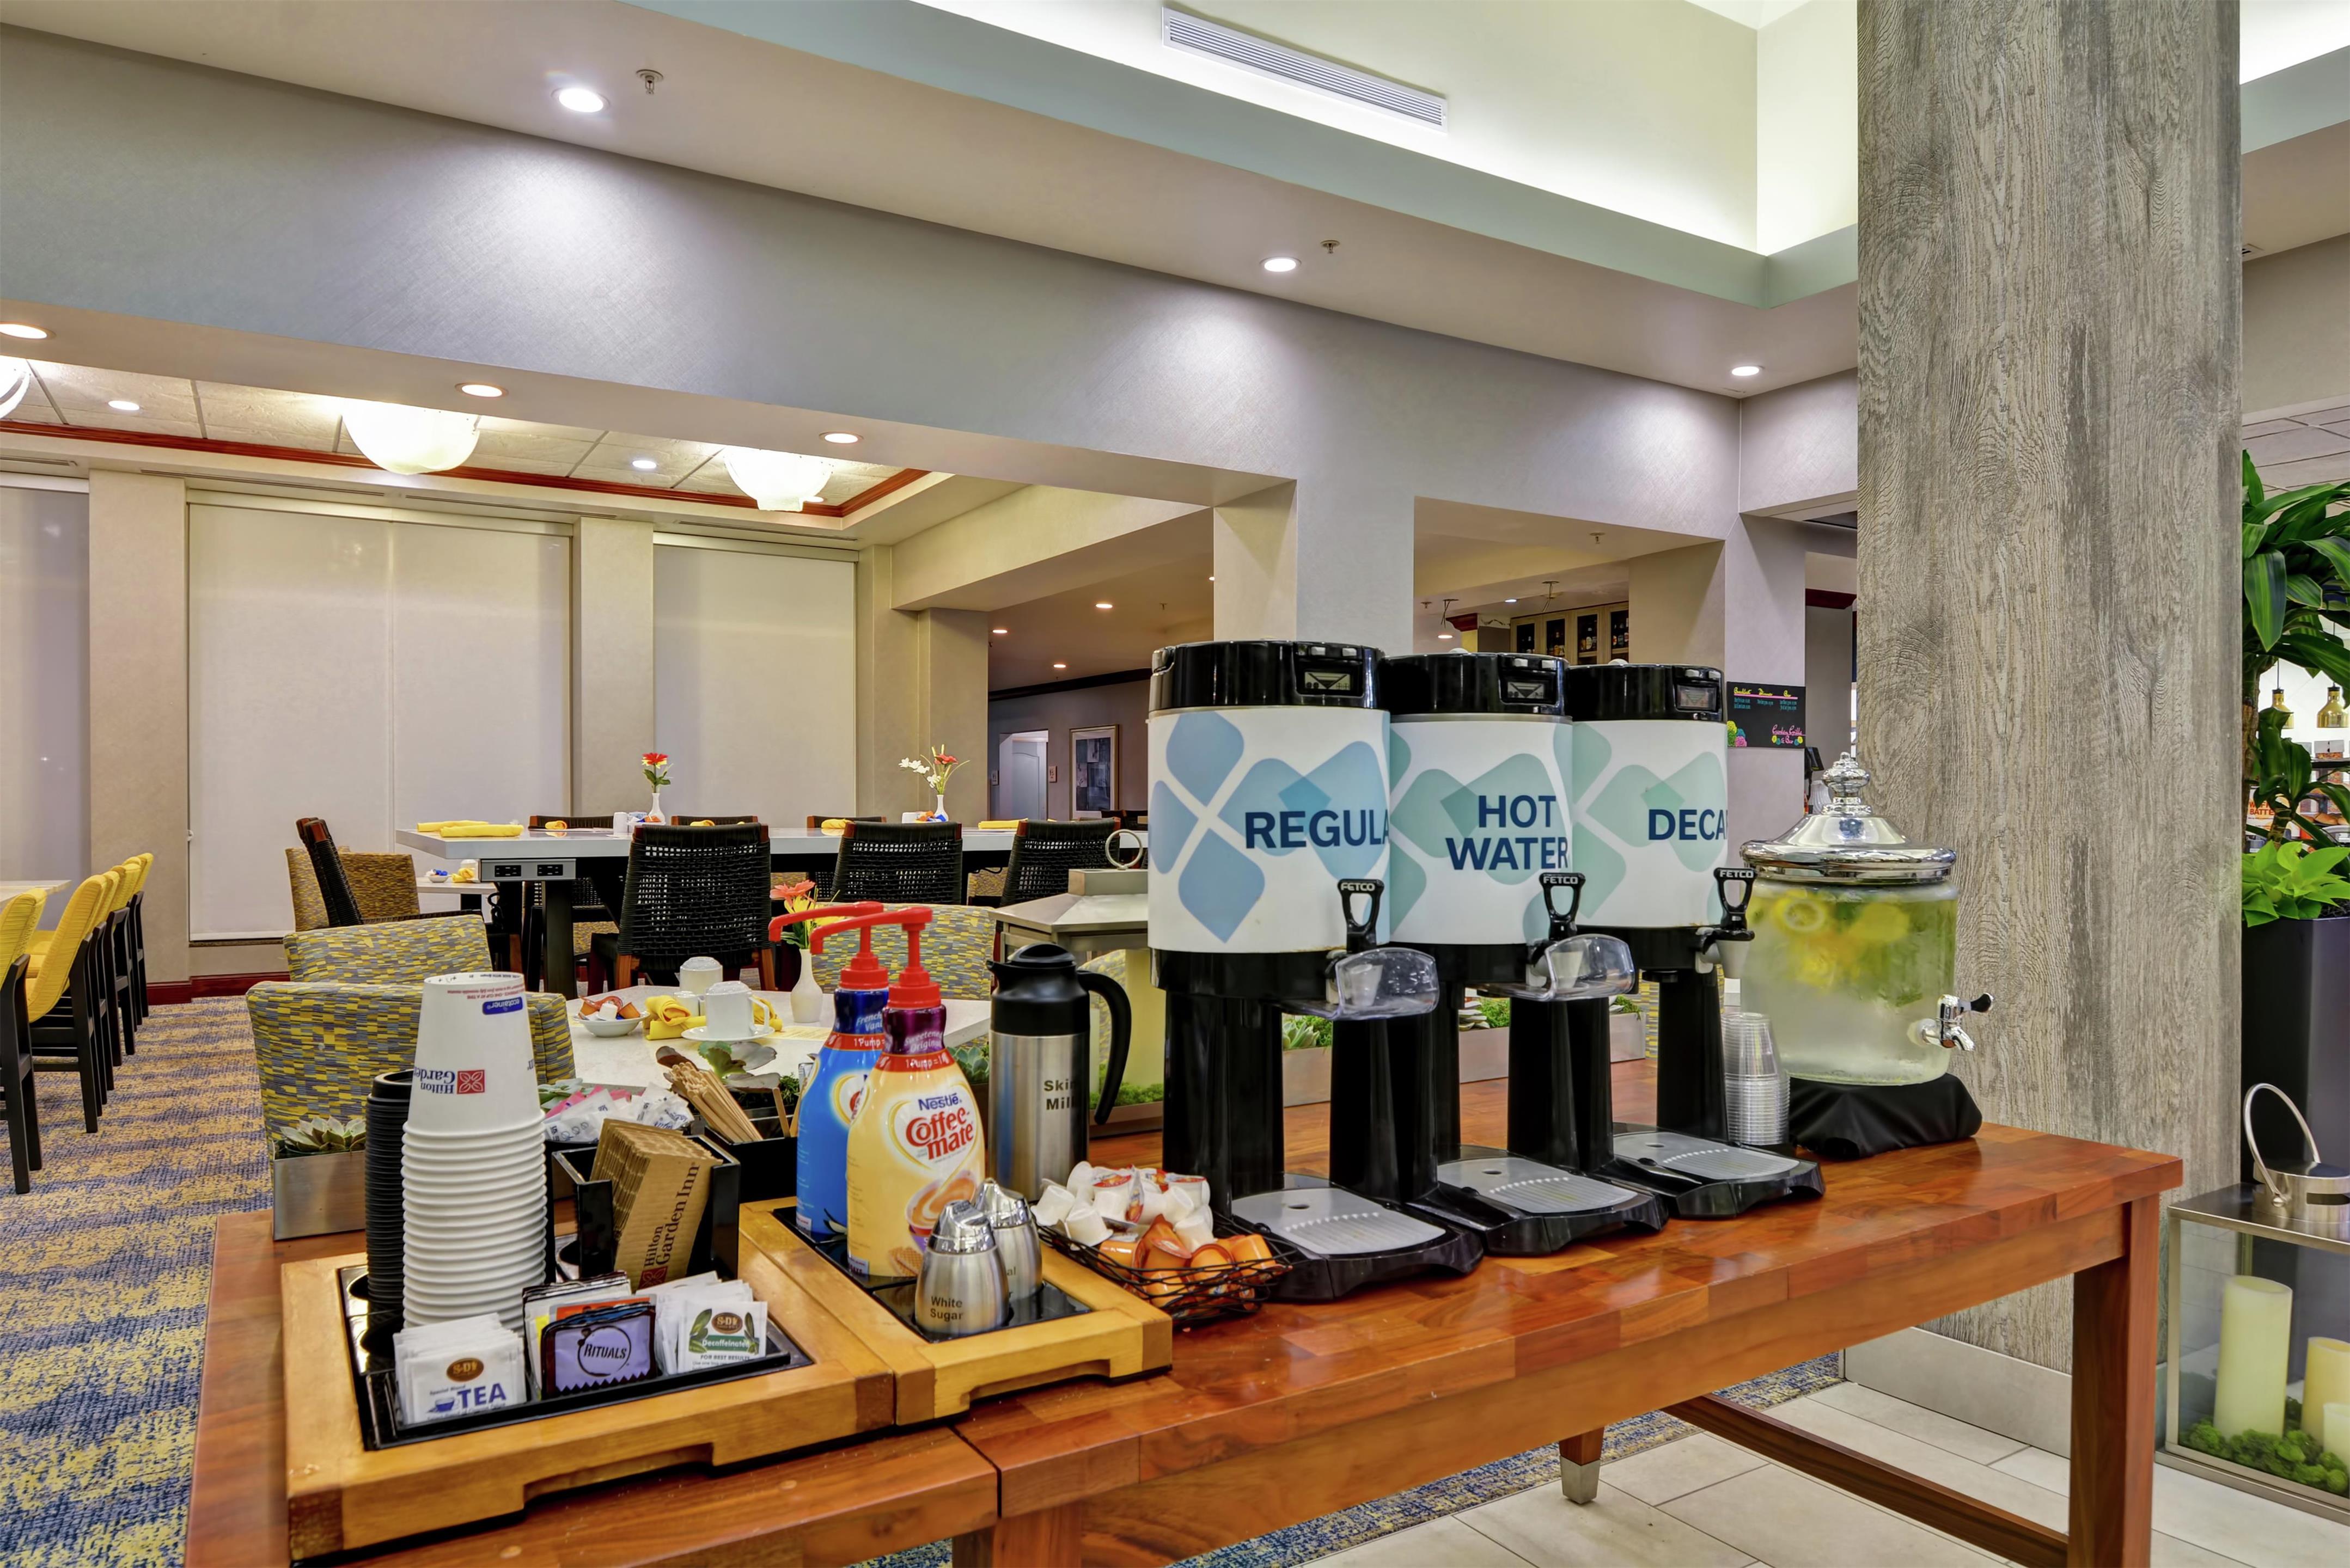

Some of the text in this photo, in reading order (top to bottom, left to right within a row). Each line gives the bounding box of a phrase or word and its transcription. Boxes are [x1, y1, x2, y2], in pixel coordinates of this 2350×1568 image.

[1479, 795, 1556, 828] HOT
[1245, 809, 1389, 849] REGULA
[1649, 809, 1728, 840] DECA
[1445, 837, 1568, 870] WATER
[1720, 870, 1754, 878] FETCO
[1341, 882, 1376, 892] FETCO
[856, 1012, 882, 1027] French
[858, 1037, 880, 1049] Pump
[420, 1082, 454, 1094] Hilton
[1043, 1079, 1072, 1092] Ski
[1046, 1097, 1073, 1110] Mil
[927, 1123, 974, 1160] mate
[655, 1199, 687, 1266] Garden
[644, 1225, 663, 1267] Hilton
[931, 1296, 962, 1308] White
[930, 1308, 963, 1322] Sugar
[583, 1343, 627, 1359] RITUALS
[457, 1383, 506, 1408] TEA
